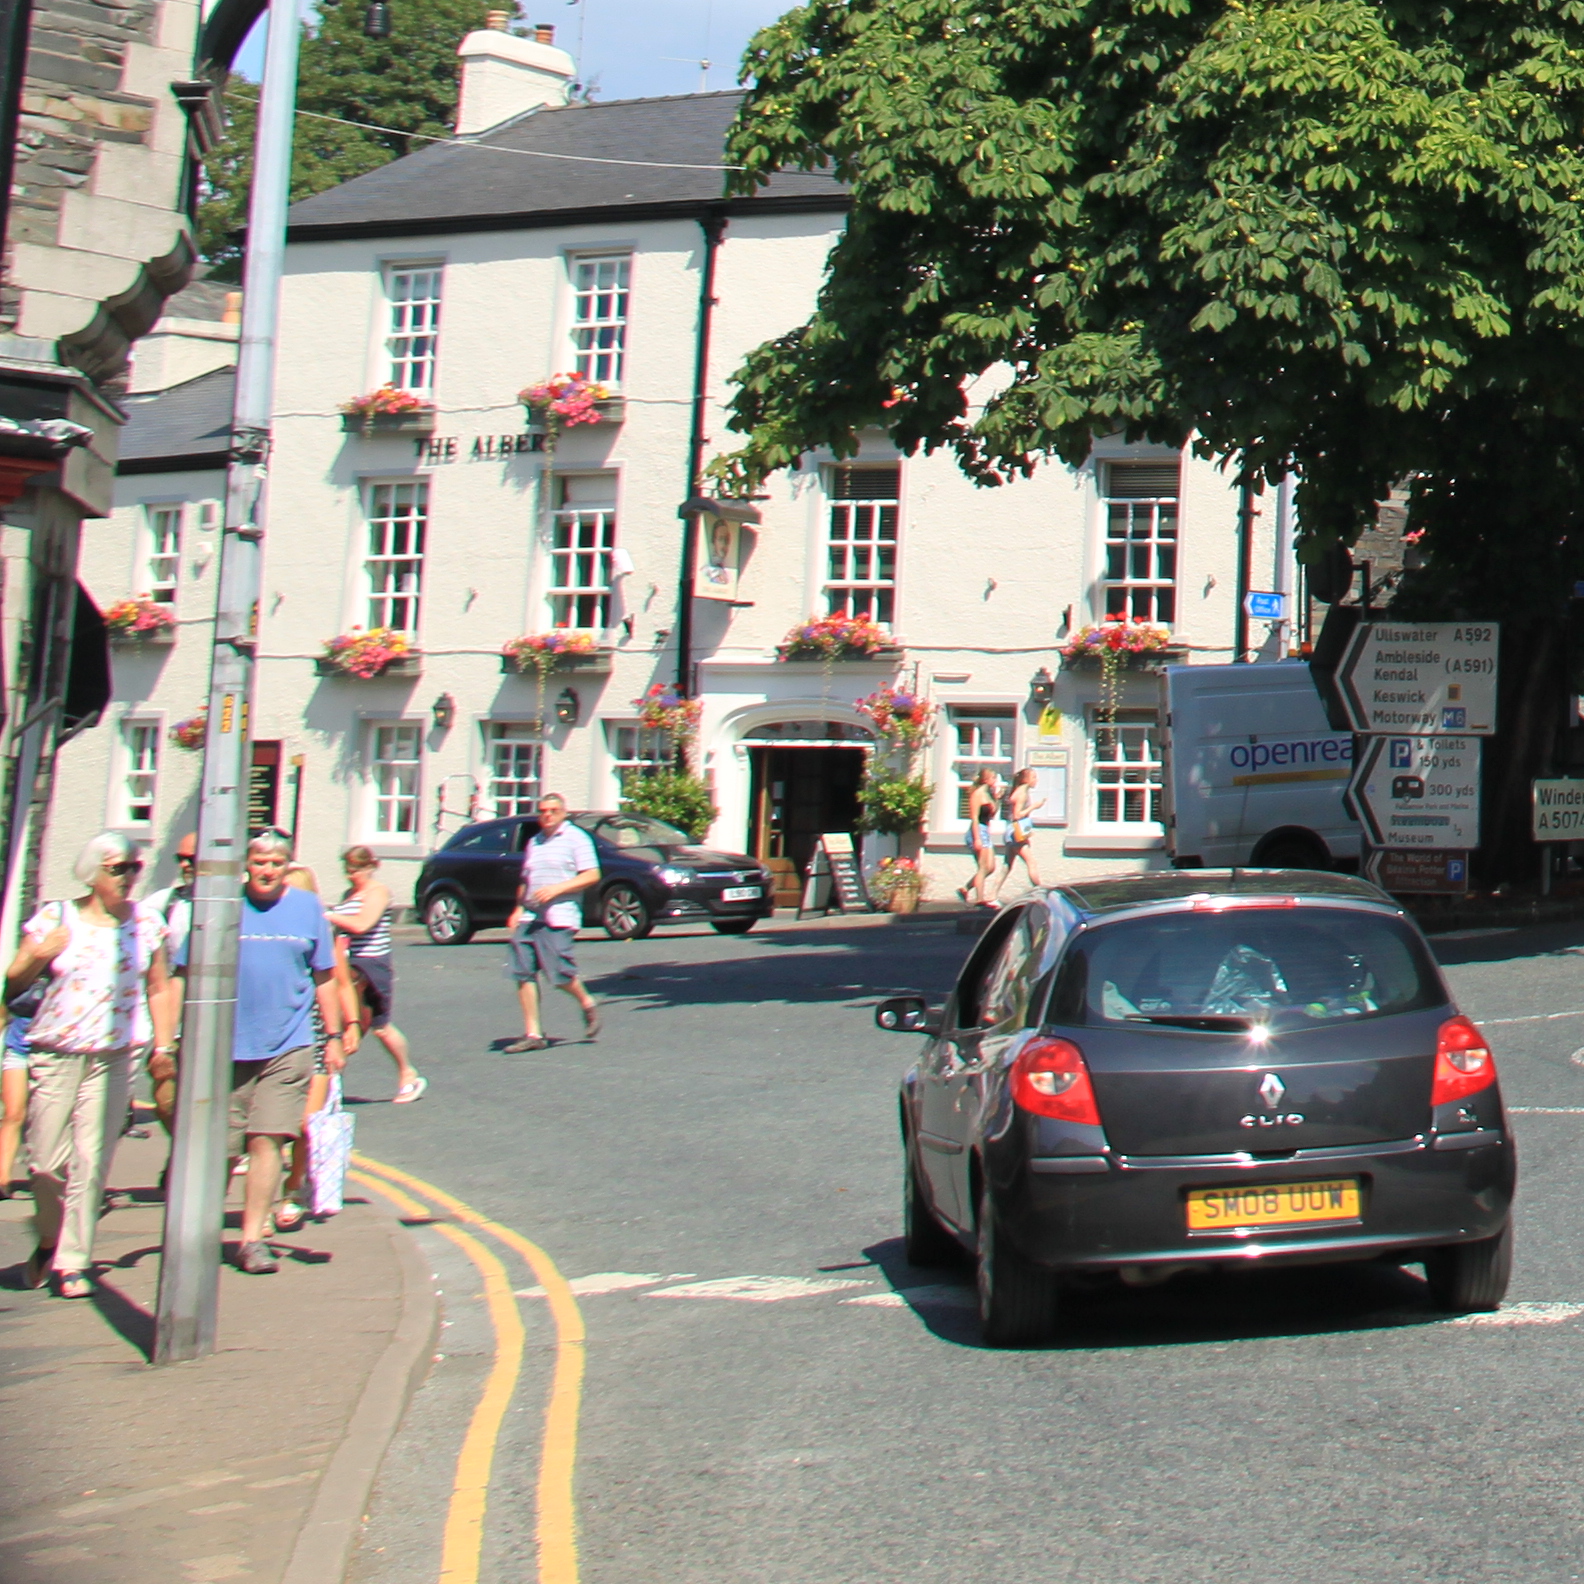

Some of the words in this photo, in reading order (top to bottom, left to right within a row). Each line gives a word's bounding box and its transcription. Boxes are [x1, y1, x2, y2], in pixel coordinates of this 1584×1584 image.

[414, 436, 458, 457] THE
[471, 433, 560, 455] ALBER
[1375, 628, 1438, 642] Ullswater
[1375, 650, 1440, 664] Ambleside
[1373, 668, 1418, 681] Kendal
[1373, 690, 1426, 703] Keswick
[1373, 710, 1437, 726] Motorway
[1443, 710, 1465, 725] M6
[1230, 738, 1353, 772] openrea
[1394, 742, 1410, 767] P
[1417, 739, 1424, 750] &
[1429, 738, 1467, 750] Toilets
[1419, 756, 1439, 767] 150
[1442, 757, 1461, 769] yds
[1429, 784, 1452, 796] 300
[1456, 784, 1475, 798] yds
[1388, 831, 1434, 843] Museum
[1390, 852, 1404, 862] The
[1406, 852, 1432, 862] World
[1433, 852, 1443, 862] of
[1419, 863, 1445, 875] Potter
[1451, 862, 1461, 879] P
[1239, 1113, 1305, 1127] CLIO
[1203, 1187, 1280, 1219] SM08
[1289, 1183, 1345, 1212] UUW
